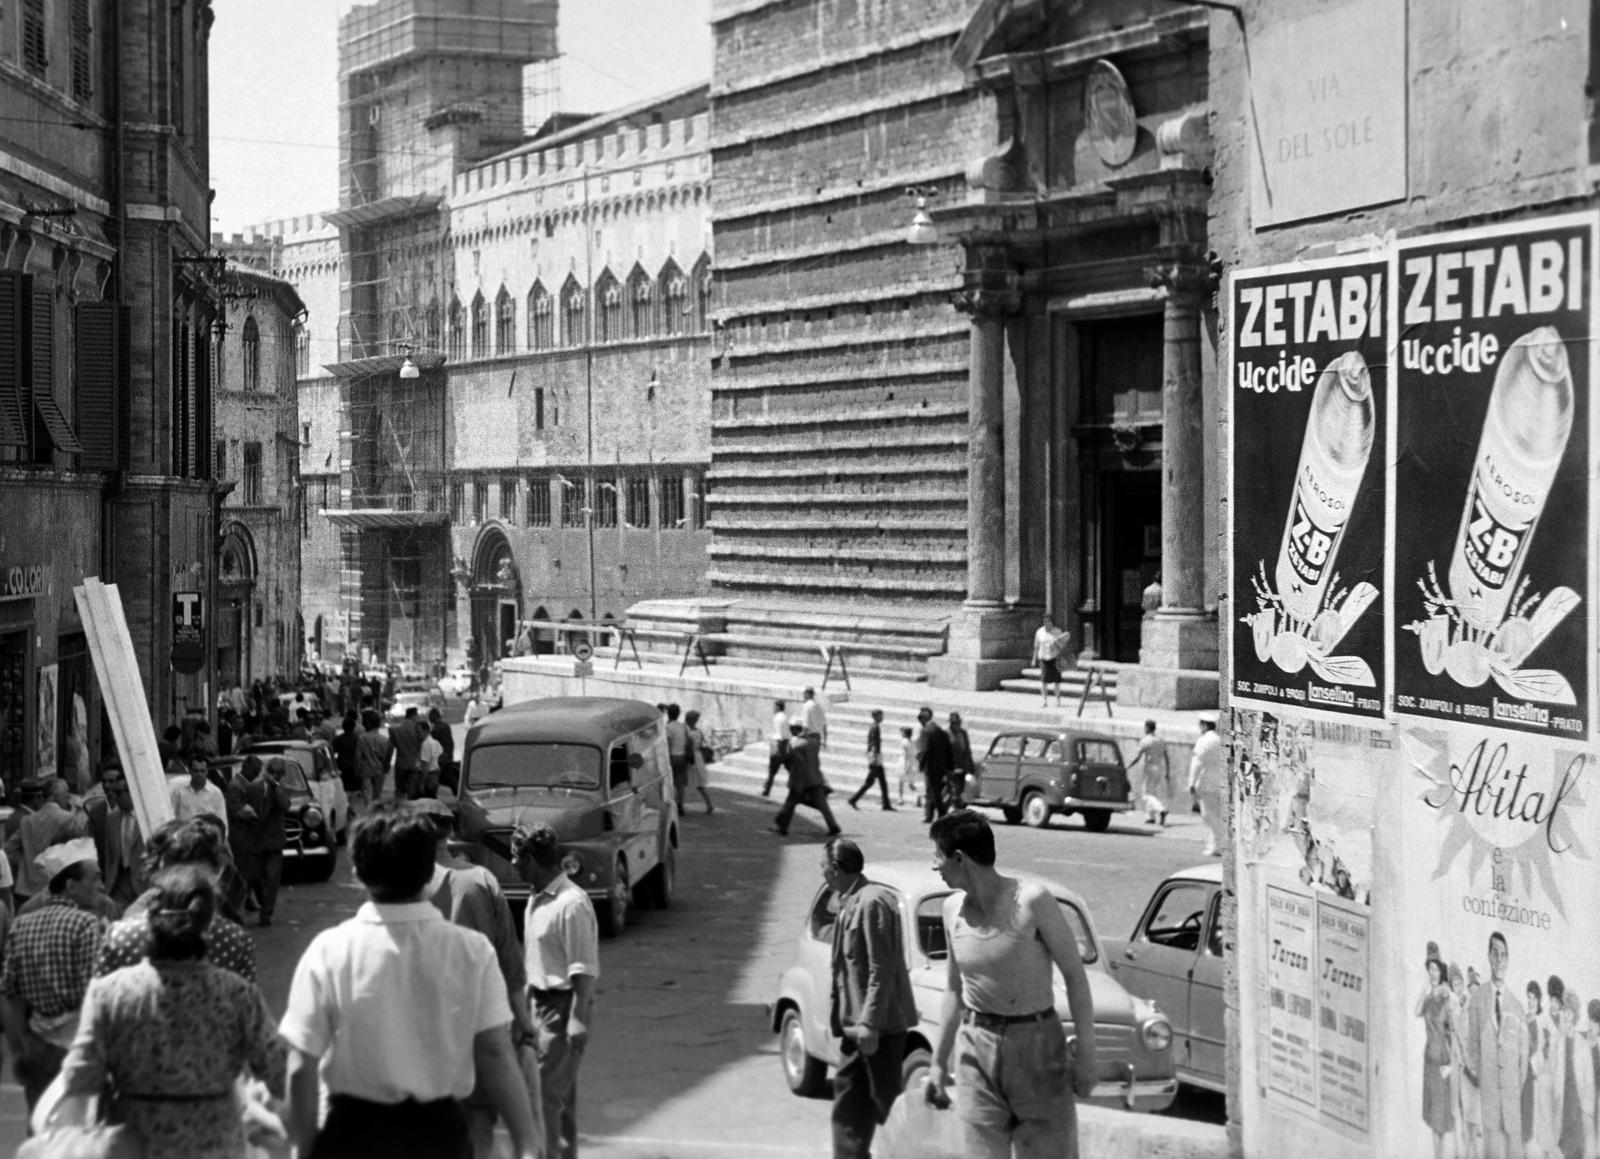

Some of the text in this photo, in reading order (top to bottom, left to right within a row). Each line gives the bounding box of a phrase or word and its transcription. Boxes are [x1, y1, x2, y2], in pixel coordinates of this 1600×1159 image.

[1308, 72, 1341, 103] VIA
[1278, 116, 1373, 162] DEL SOLE
[1404, 237, 1583, 325] ZETABI
[1240, 273, 1381, 348] ZETABI
[1403, 326, 1499, 374] uccide
[1238, 350, 1316, 392] uccide
[177, 594, 198, 625] T
[1419, 697, 1453, 713] ZAMPOLI
[1464, 705, 1489, 718] BROGI
[1424, 738, 1586, 853] Abital
[1493, 847, 1502, 863] e
[1492, 865, 1506, 892] la
[1463, 895, 1552, 930] confezione
